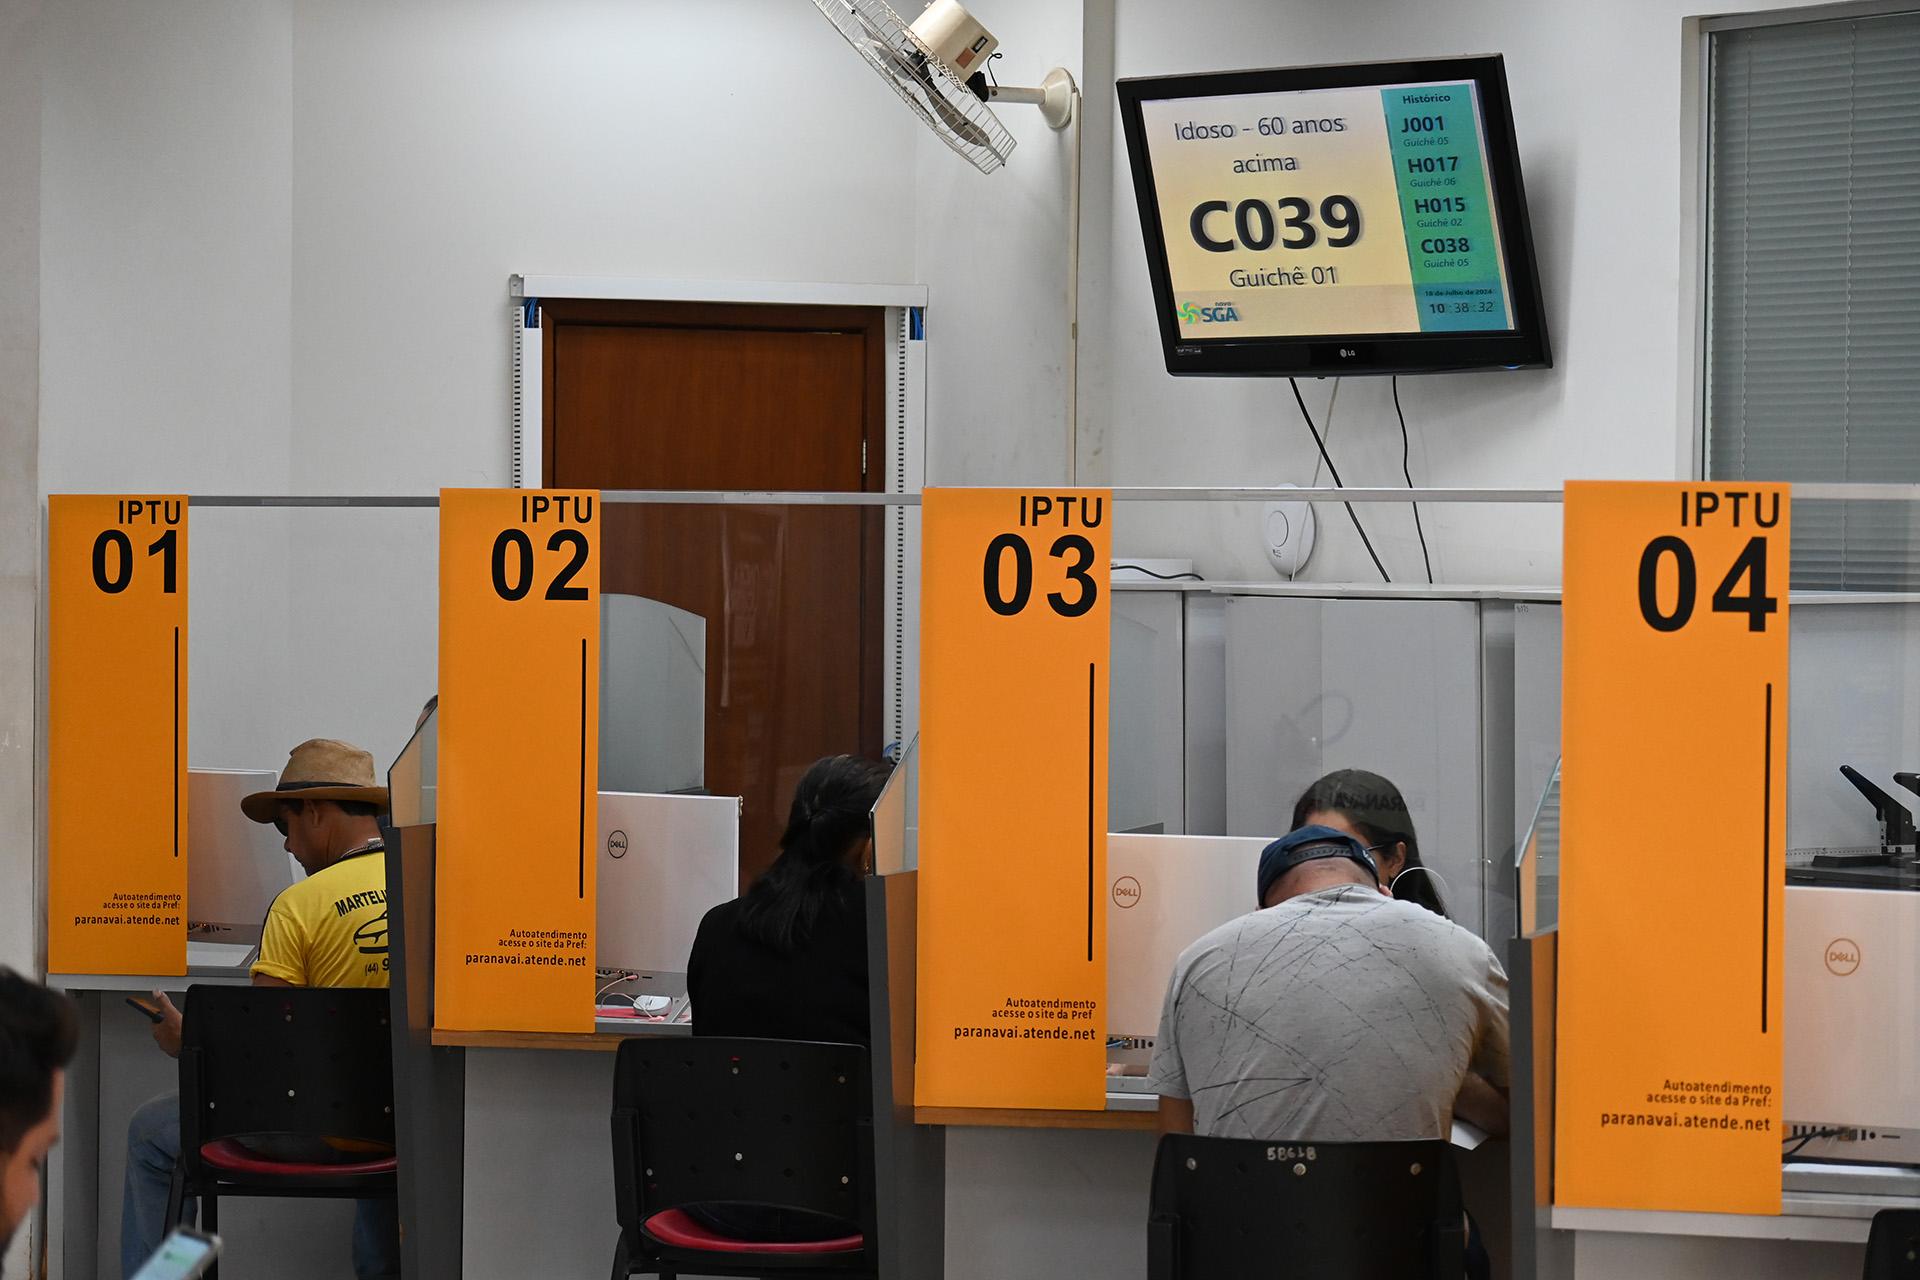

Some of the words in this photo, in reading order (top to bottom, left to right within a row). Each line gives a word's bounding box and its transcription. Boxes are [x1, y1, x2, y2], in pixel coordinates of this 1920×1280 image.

[1402, 93, 1451, 104] Histórico
[1174, 121, 1235, 141] Idoso
[1257, 116, 1285, 136] 60
[1291, 116, 1346, 135] anos
[1401, 115, 1444, 133] J001
[1437, 136, 1449, 145] 05
[1233, 153, 1298, 173] acima
[1407, 156, 1459, 173] H017
[1443, 177, 1457, 186] 06
[1414, 197, 1466, 213] H015
[1189, 194, 1362, 253] C039
[1451, 218, 1463, 227] 02
[1420, 237, 1470, 254] C038
[1457, 258, 1470, 267] 05
[1229, 265, 1305, 288] Guichê
[1311, 265, 1337, 284] 01
[1201, 306, 1239, 323] SGA
[118, 500, 181, 525] IPTU
[522, 495, 592, 524] IPTU
[1020, 495, 1102, 528] IPTU
[1681, 491, 1780, 528] IPTU
[92, 529, 177, 594] 01
[491, 528, 589, 601] 02
[983, 533, 1098, 617] 03
[1638, 535, 1777, 632] 04
[113, 892, 182, 901] Autoatendimento
[137, 901, 151, 909] site
[151, 901, 161, 909] da
[335, 889, 389, 917] MARTELI
[75, 914, 180, 926] paranavai.atende.net
[510, 929, 588, 940] Autoatendimento
[499, 940, 527, 948] acesse
[528, 940, 534, 948] o
[536, 939, 552, 949] site
[554, 940, 564, 949] da
[566, 940, 587, 949] Pref:
[466, 953, 587, 967] paranavai.atende.net
[1006, 998, 1097, 1010] Autoatendimento
[992, 1009, 1026, 1019] acesse
[1027, 1010, 1034, 1019] o
[1036, 1008, 1055, 1019] site
[1057, 1009, 1069, 1020] da
[954, 1026, 1096, 1041] paranavai.atende.net
[1663, 1079, 1772, 1095] Autoatendimento
[1647, 1093, 1687, 1105] acesse
[1689, 1096, 1697, 1105] o
[1700, 1094, 1722, 1106] site
[1724, 1095, 1740, 1107] da
[1742, 1095, 1772, 1108] Pref:
[1601, 1112, 1771, 1132] paranavai.atende.net
